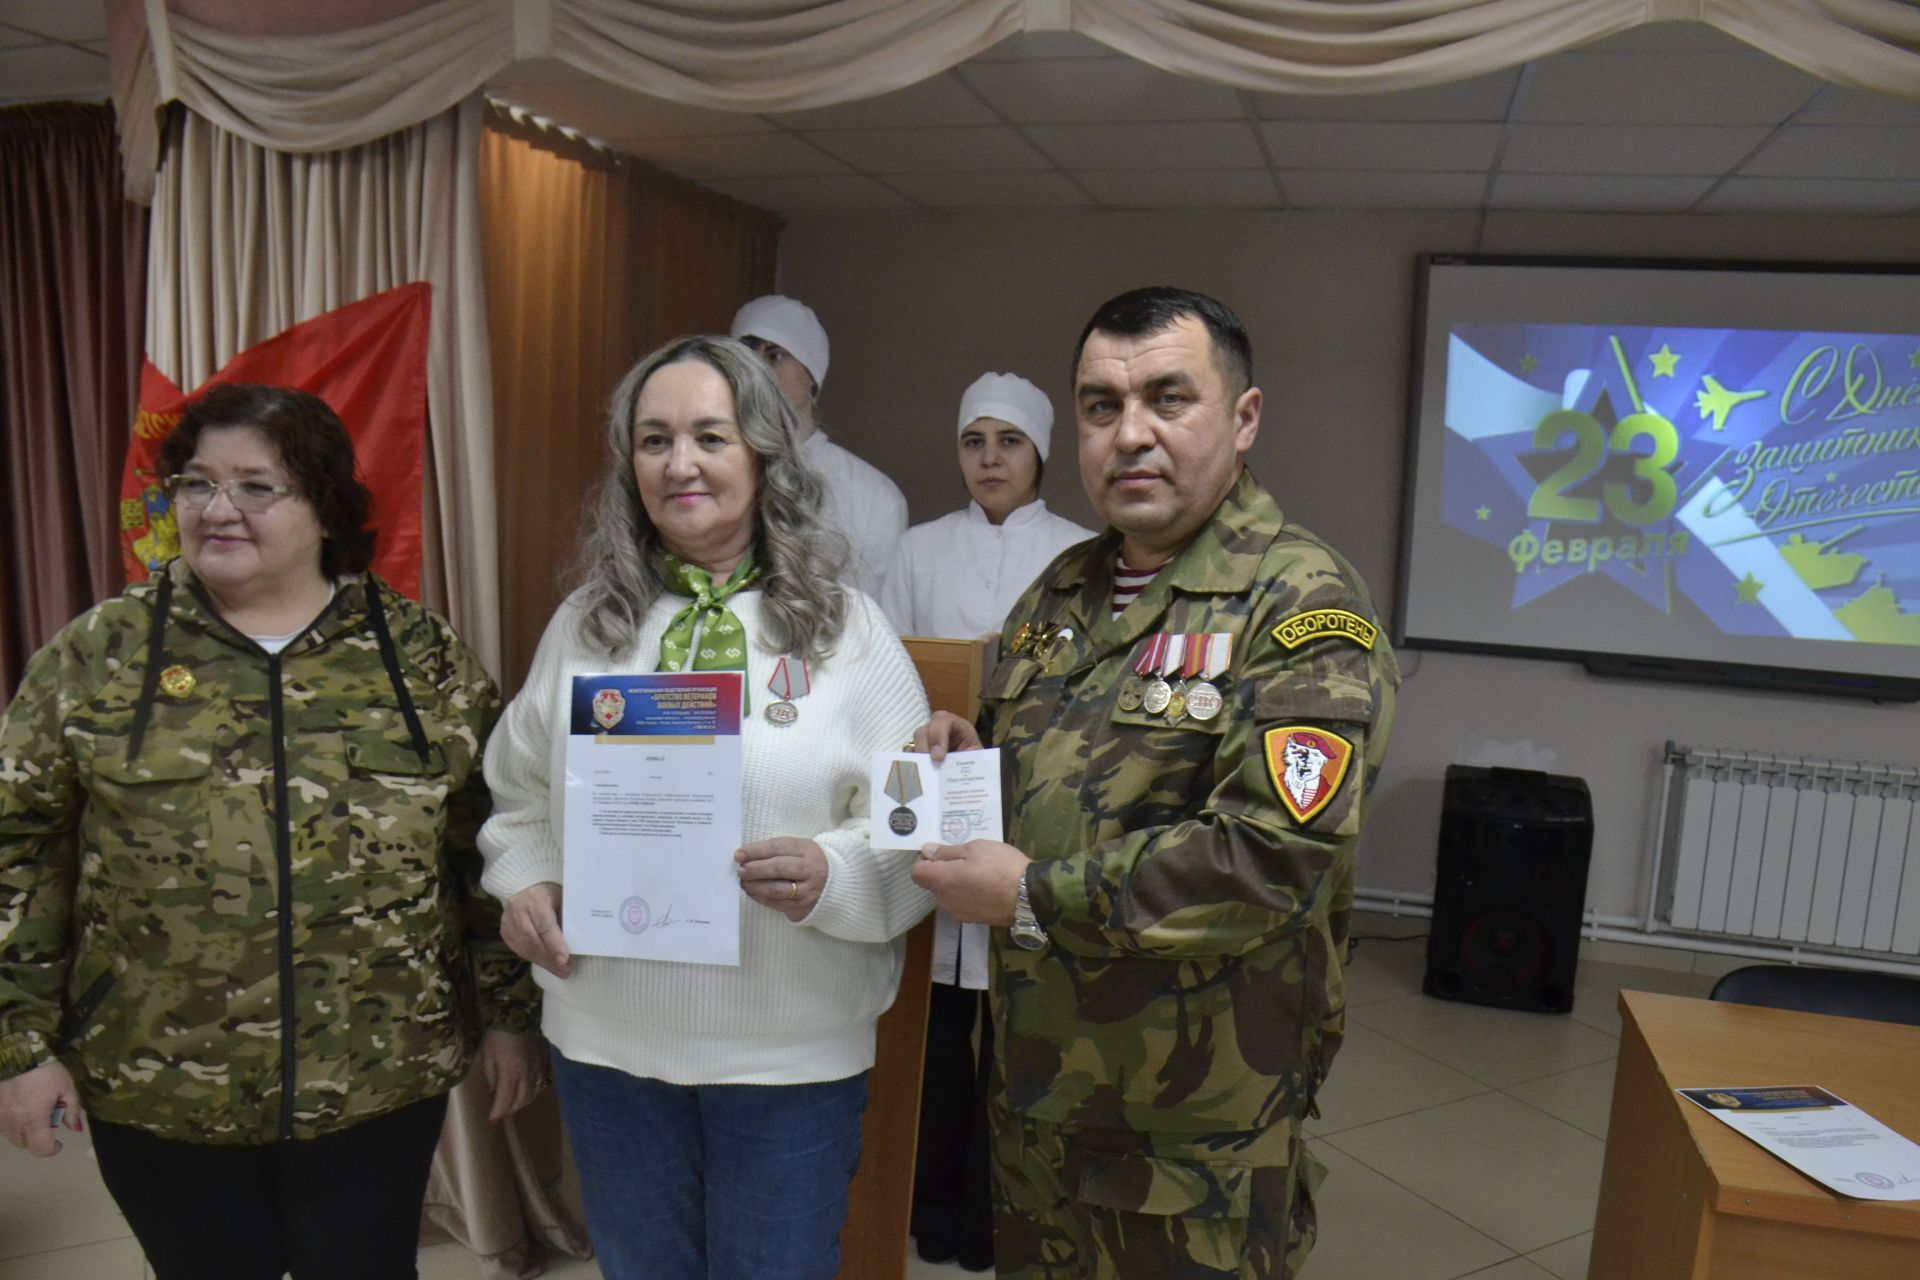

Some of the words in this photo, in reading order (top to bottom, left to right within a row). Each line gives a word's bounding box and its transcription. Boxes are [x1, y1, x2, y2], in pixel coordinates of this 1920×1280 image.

[1779, 344, 1840, 425] С
[1527, 409, 1680, 526] 23
[1744, 469, 1920, 528] Отечест
[1508, 529, 1690, 574] Февраля
[1281, 614, 1371, 642] ОБОРОТЕНЬ
